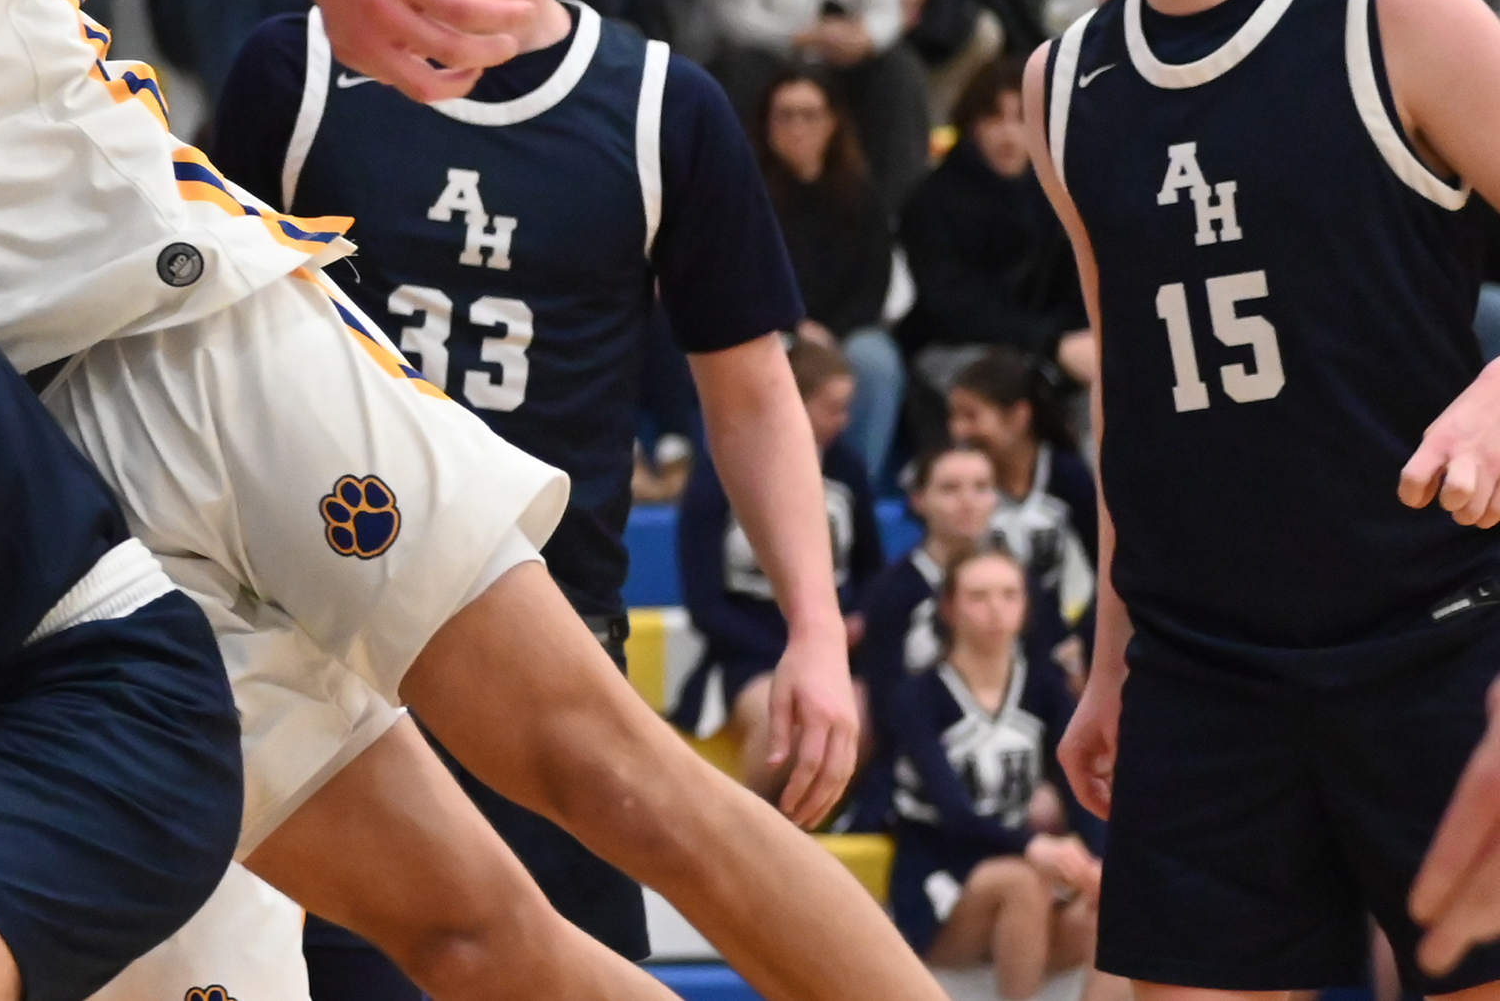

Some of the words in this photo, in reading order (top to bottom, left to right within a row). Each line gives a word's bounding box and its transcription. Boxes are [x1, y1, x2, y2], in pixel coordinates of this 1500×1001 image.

[428, 168, 518, 271] AH
[1157, 142, 1243, 246] AH
[388, 285, 534, 412] 33
[1156, 269, 1286, 413] 15
